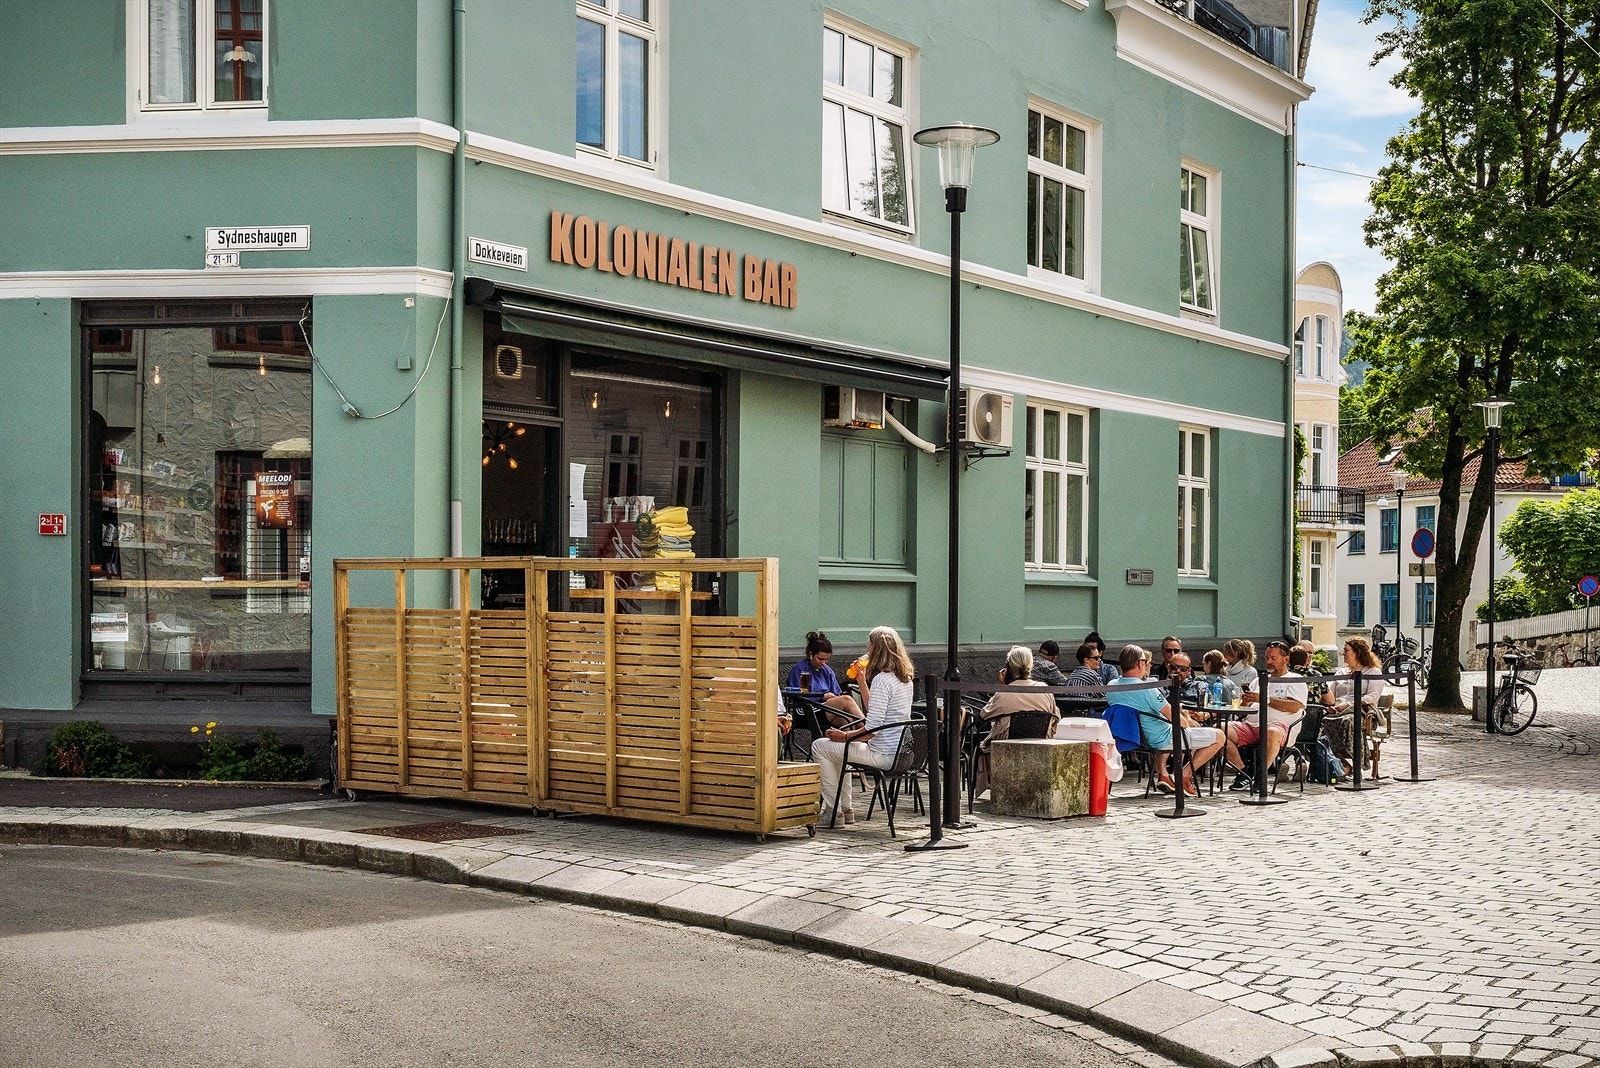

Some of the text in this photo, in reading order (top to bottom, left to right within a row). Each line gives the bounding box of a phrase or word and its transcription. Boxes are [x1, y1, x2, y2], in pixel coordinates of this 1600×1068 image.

[217, 229, 297, 248] Sydneshaugen
[475, 242, 523, 266] Dokkeveien
[550, 210, 798, 309] KOLONIALEN BAR
[258, 474, 292, 483] MEELODI
